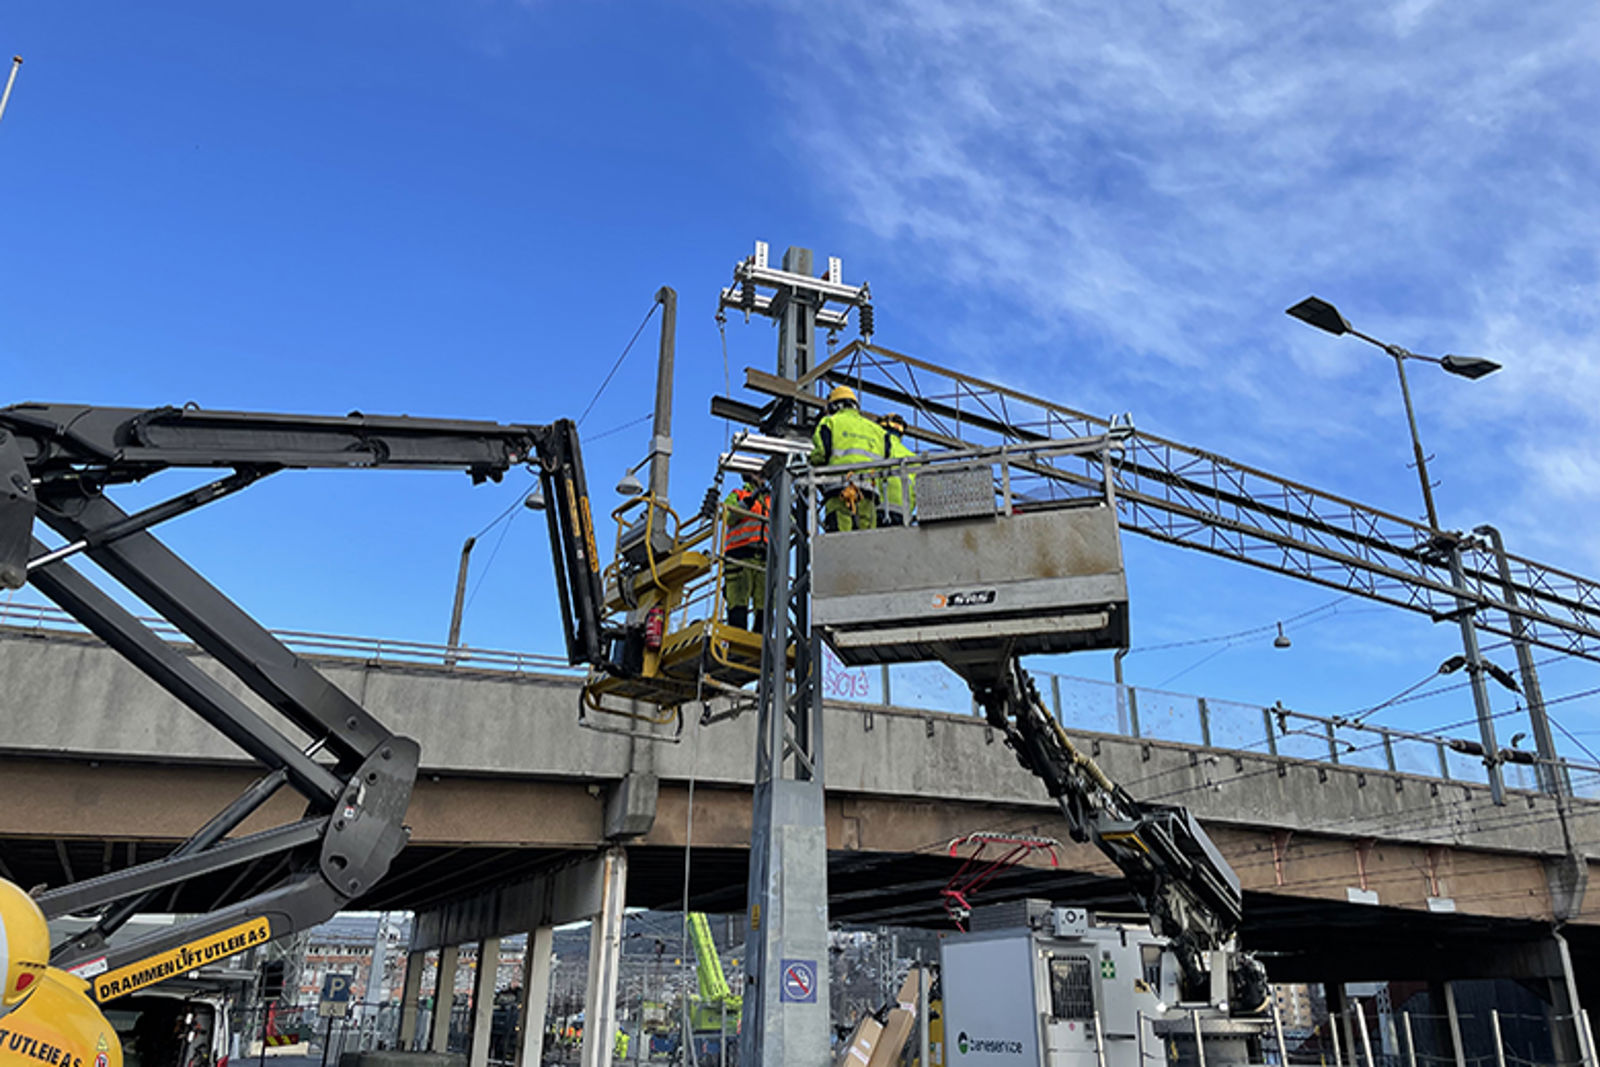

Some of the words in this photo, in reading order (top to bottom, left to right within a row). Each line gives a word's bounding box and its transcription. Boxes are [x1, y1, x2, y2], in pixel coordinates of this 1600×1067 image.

[100, 960, 175, 998] DRAMMEN
[175, 947, 202, 970] LIFT
[204, 933, 247, 960] UTLEIE
[329, 977, 346, 998] P
[9, 1032, 62, 1066] UTLEIE
